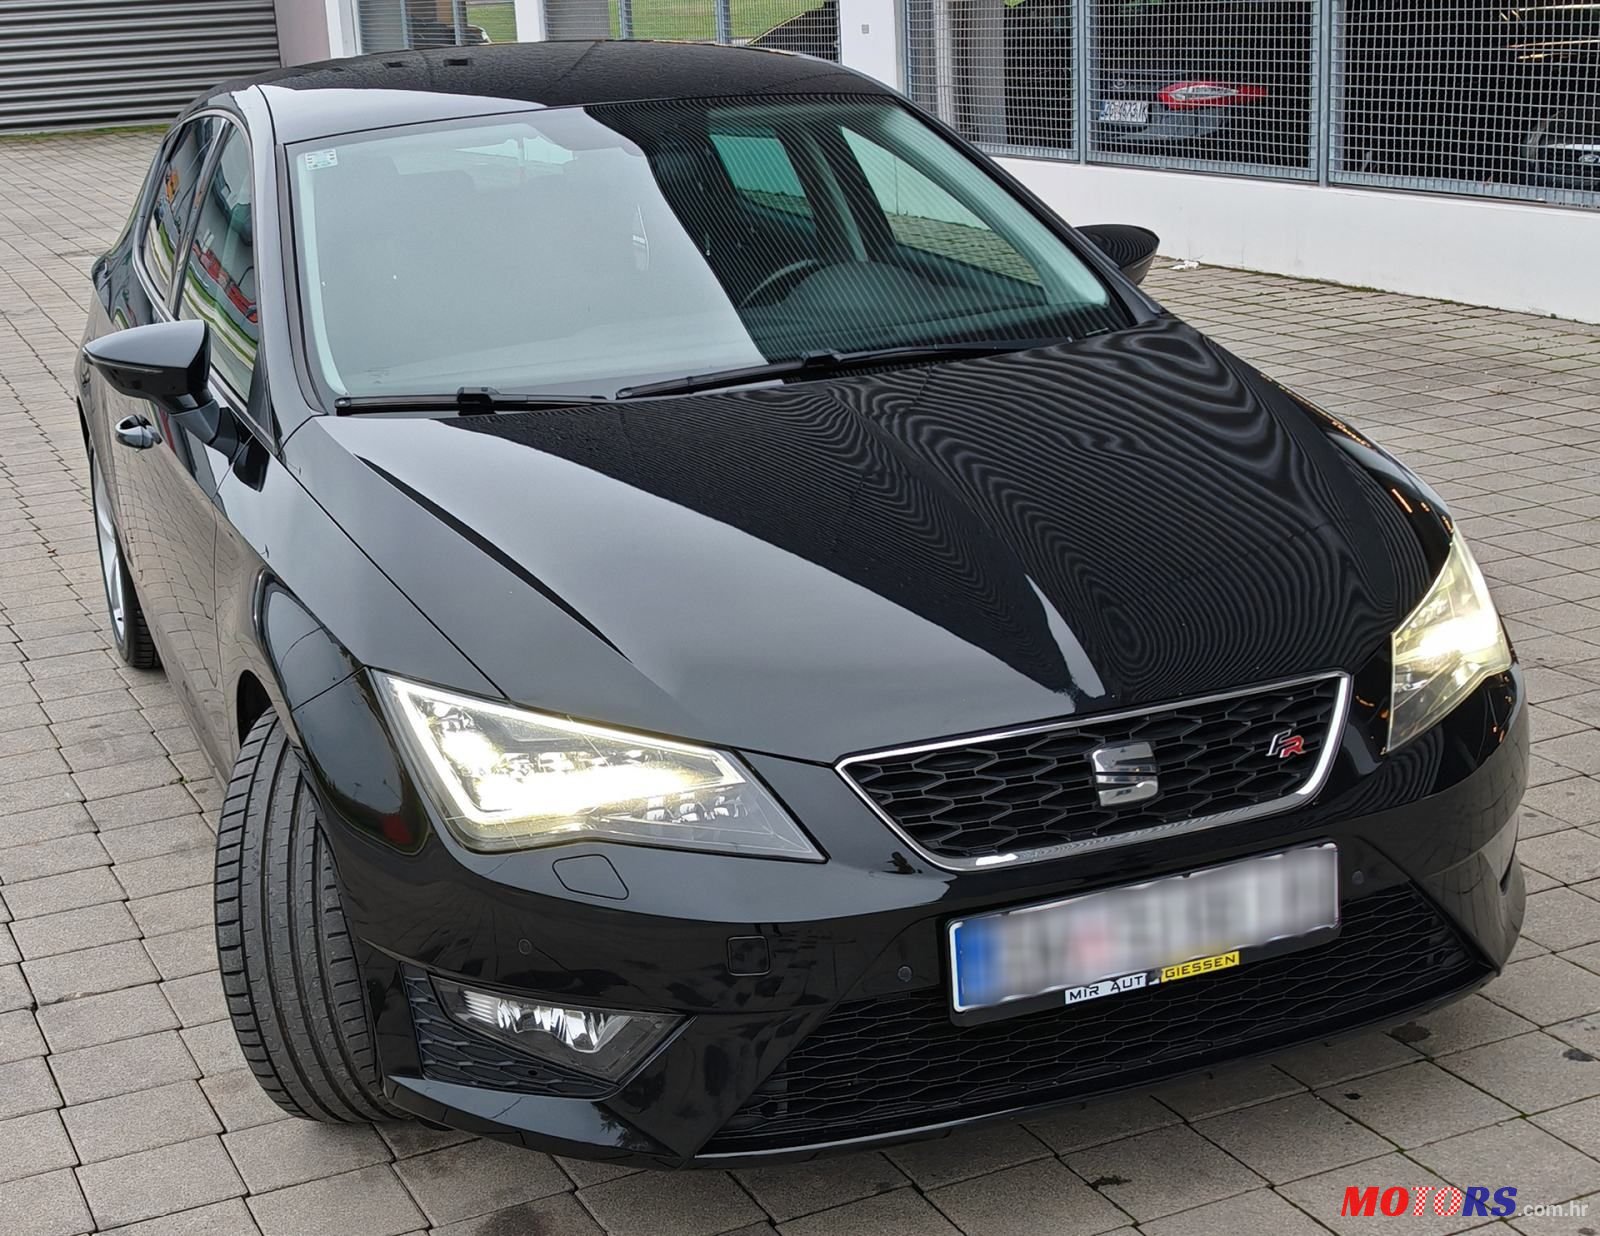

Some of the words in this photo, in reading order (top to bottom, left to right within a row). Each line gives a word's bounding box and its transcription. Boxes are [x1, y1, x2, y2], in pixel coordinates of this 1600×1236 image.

[1265, 729, 1306, 758] FR
[1069, 985, 1100, 1001] MIR
[1110, 974, 1158, 993] AUT
[1164, 953, 1237, 979] GIESSEN
